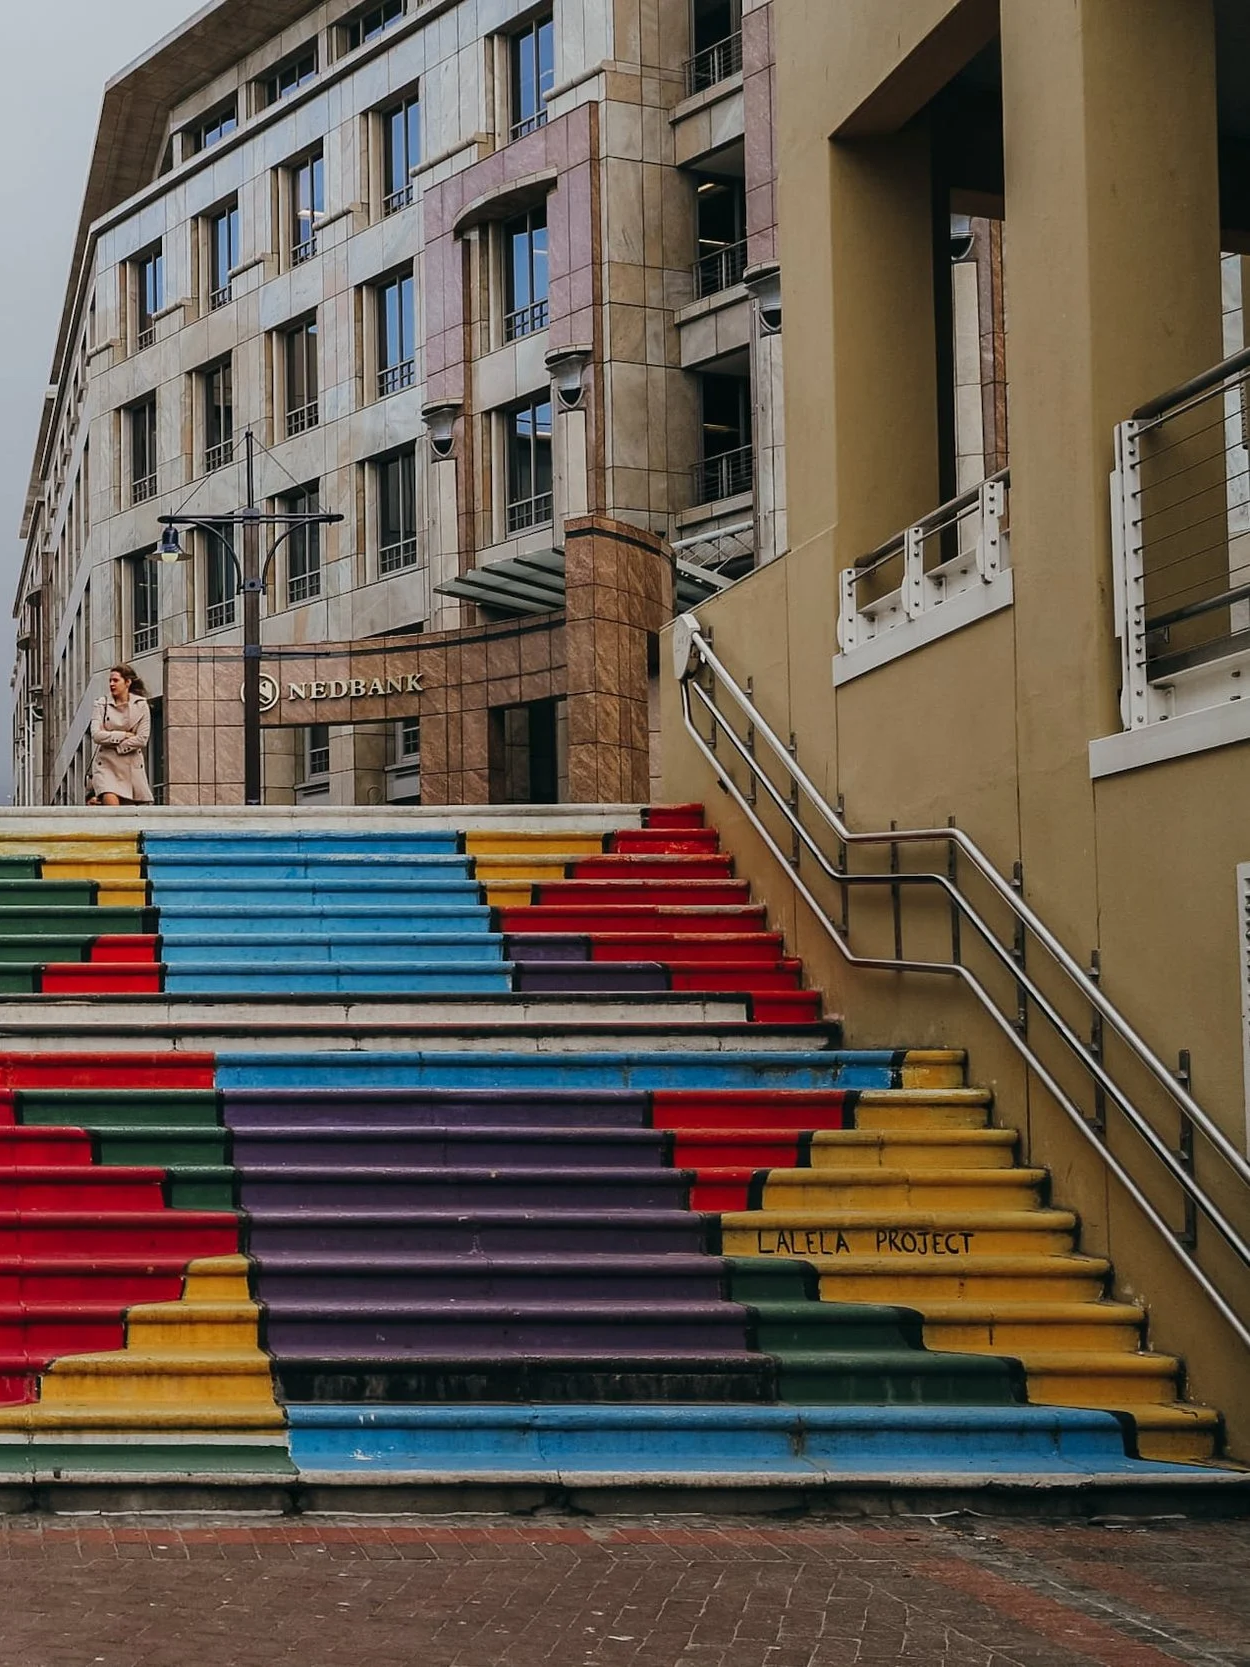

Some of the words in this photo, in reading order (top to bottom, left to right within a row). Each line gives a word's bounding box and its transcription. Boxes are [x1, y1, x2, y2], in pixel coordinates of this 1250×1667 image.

[288, 673, 425, 701] NEDBANK
[757, 1229, 850, 1255] LALELA
[876, 1229, 974, 1255] PROJECT
